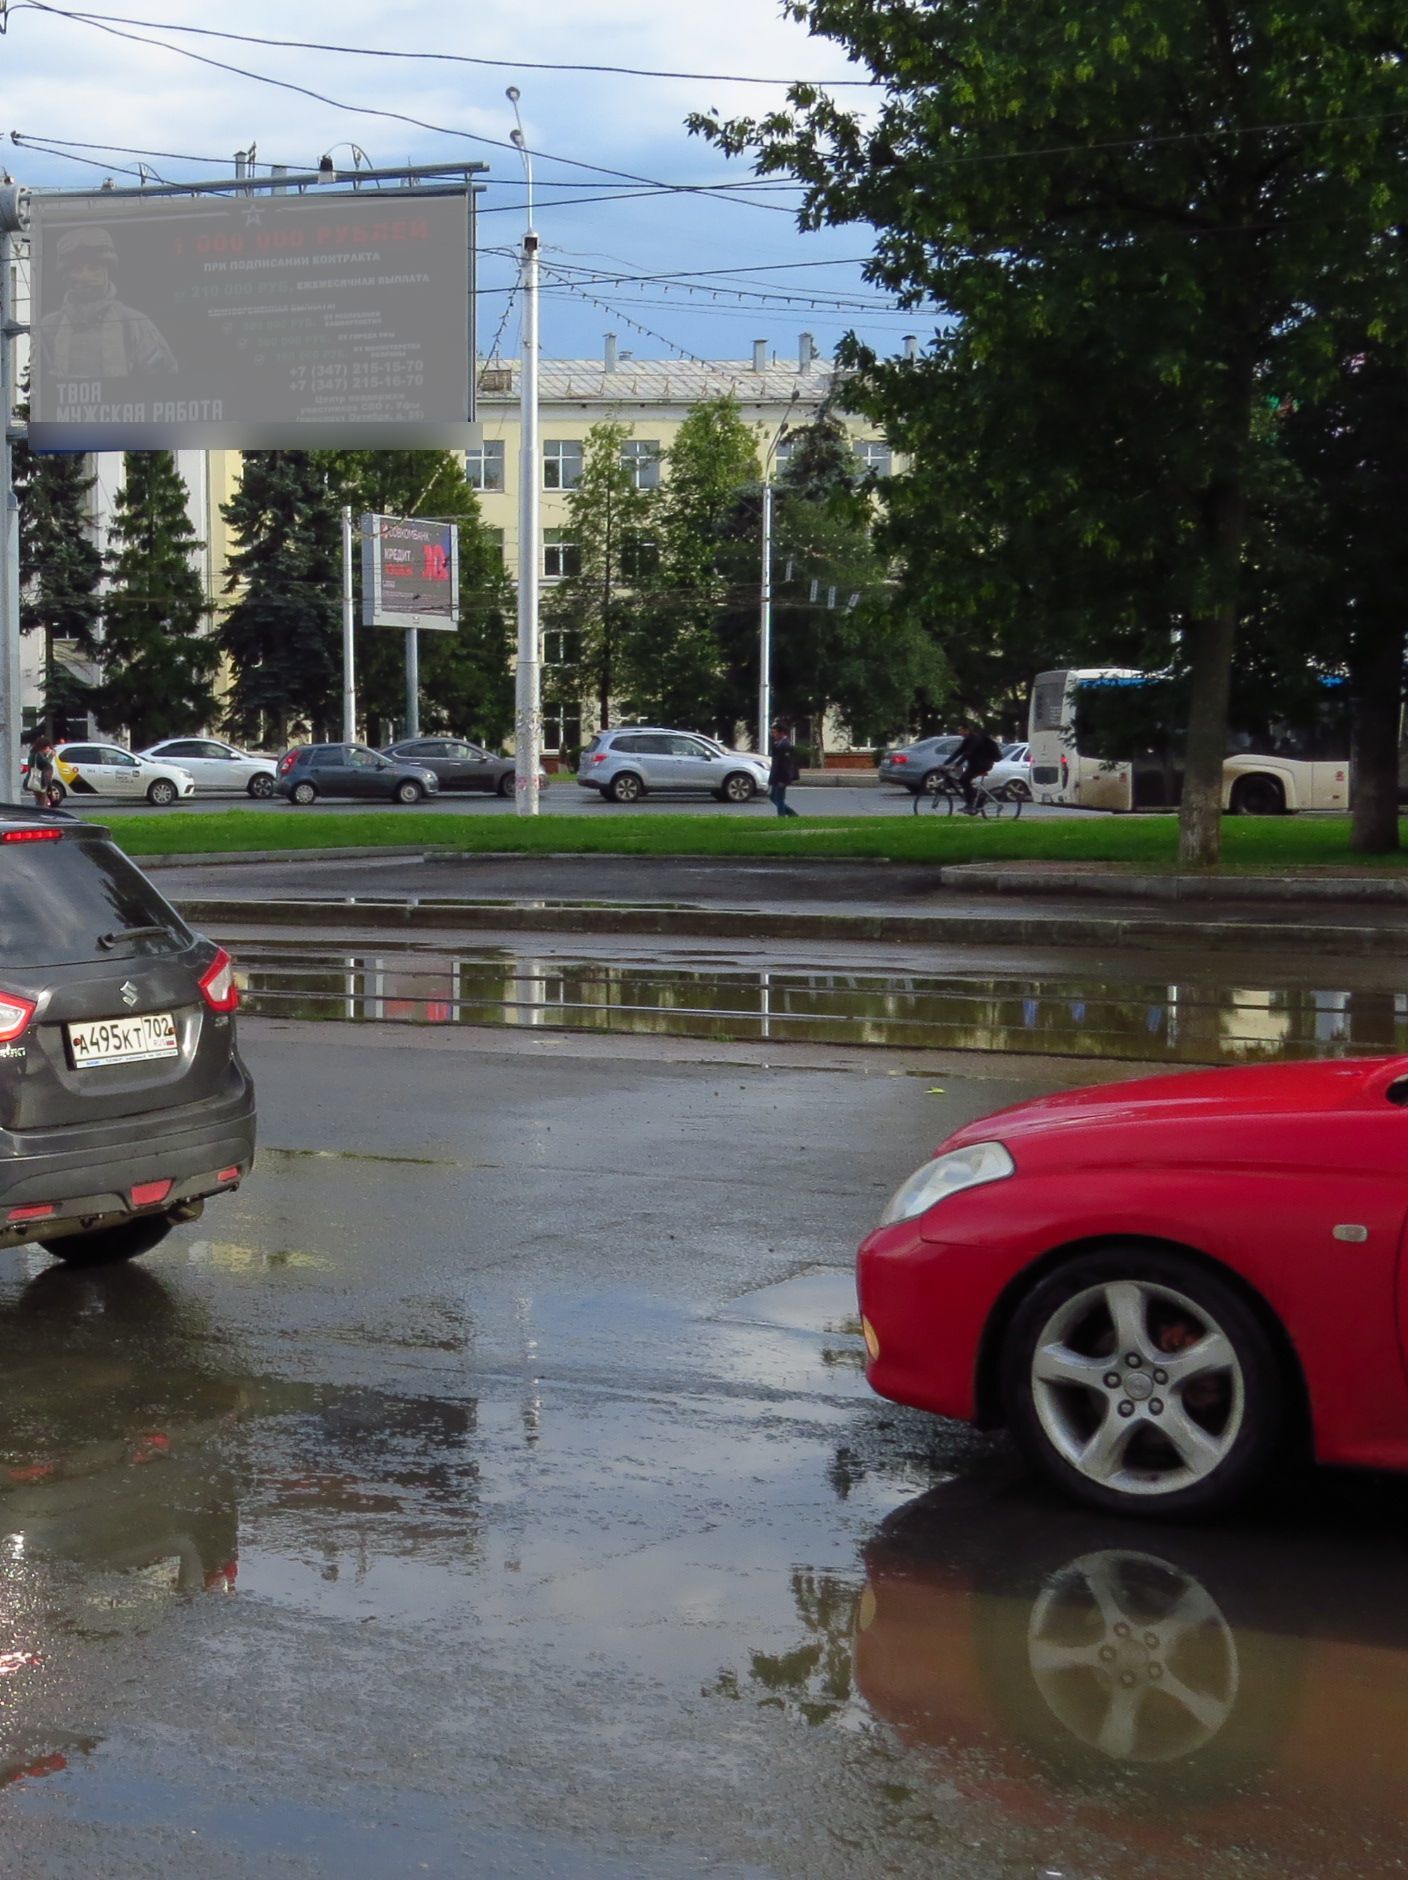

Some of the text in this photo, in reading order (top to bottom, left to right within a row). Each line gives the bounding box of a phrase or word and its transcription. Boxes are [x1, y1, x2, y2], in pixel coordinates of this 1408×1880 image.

[313, 252, 381, 265] КОНТРАКТА
[56, 382, 102, 404] ТВОЯ
[153, 400, 223, 422] РАБОТА
[80, 1017, 171, 1055] А495КТ 702
